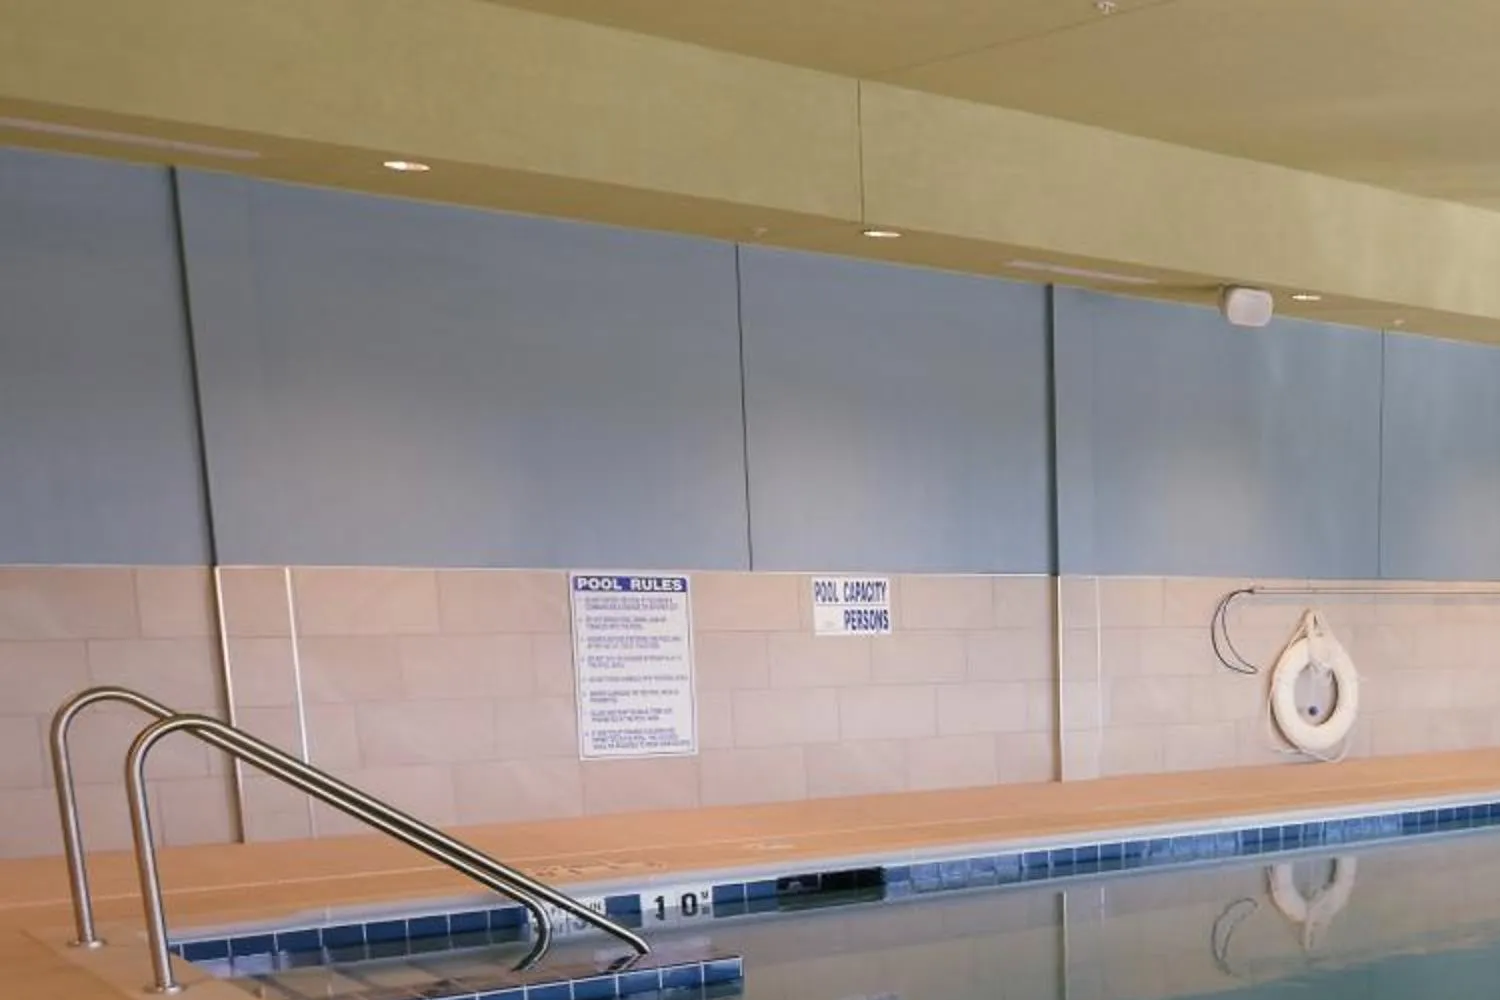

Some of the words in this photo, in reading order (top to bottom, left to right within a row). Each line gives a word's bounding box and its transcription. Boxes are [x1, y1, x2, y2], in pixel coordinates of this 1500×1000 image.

[577, 576, 622, 591] POOL
[630, 577, 683, 592] RULES
[814, 581, 839, 602] POOL
[843, 581, 887, 602] CAPACITY
[844, 609, 889, 631] PERSONS
